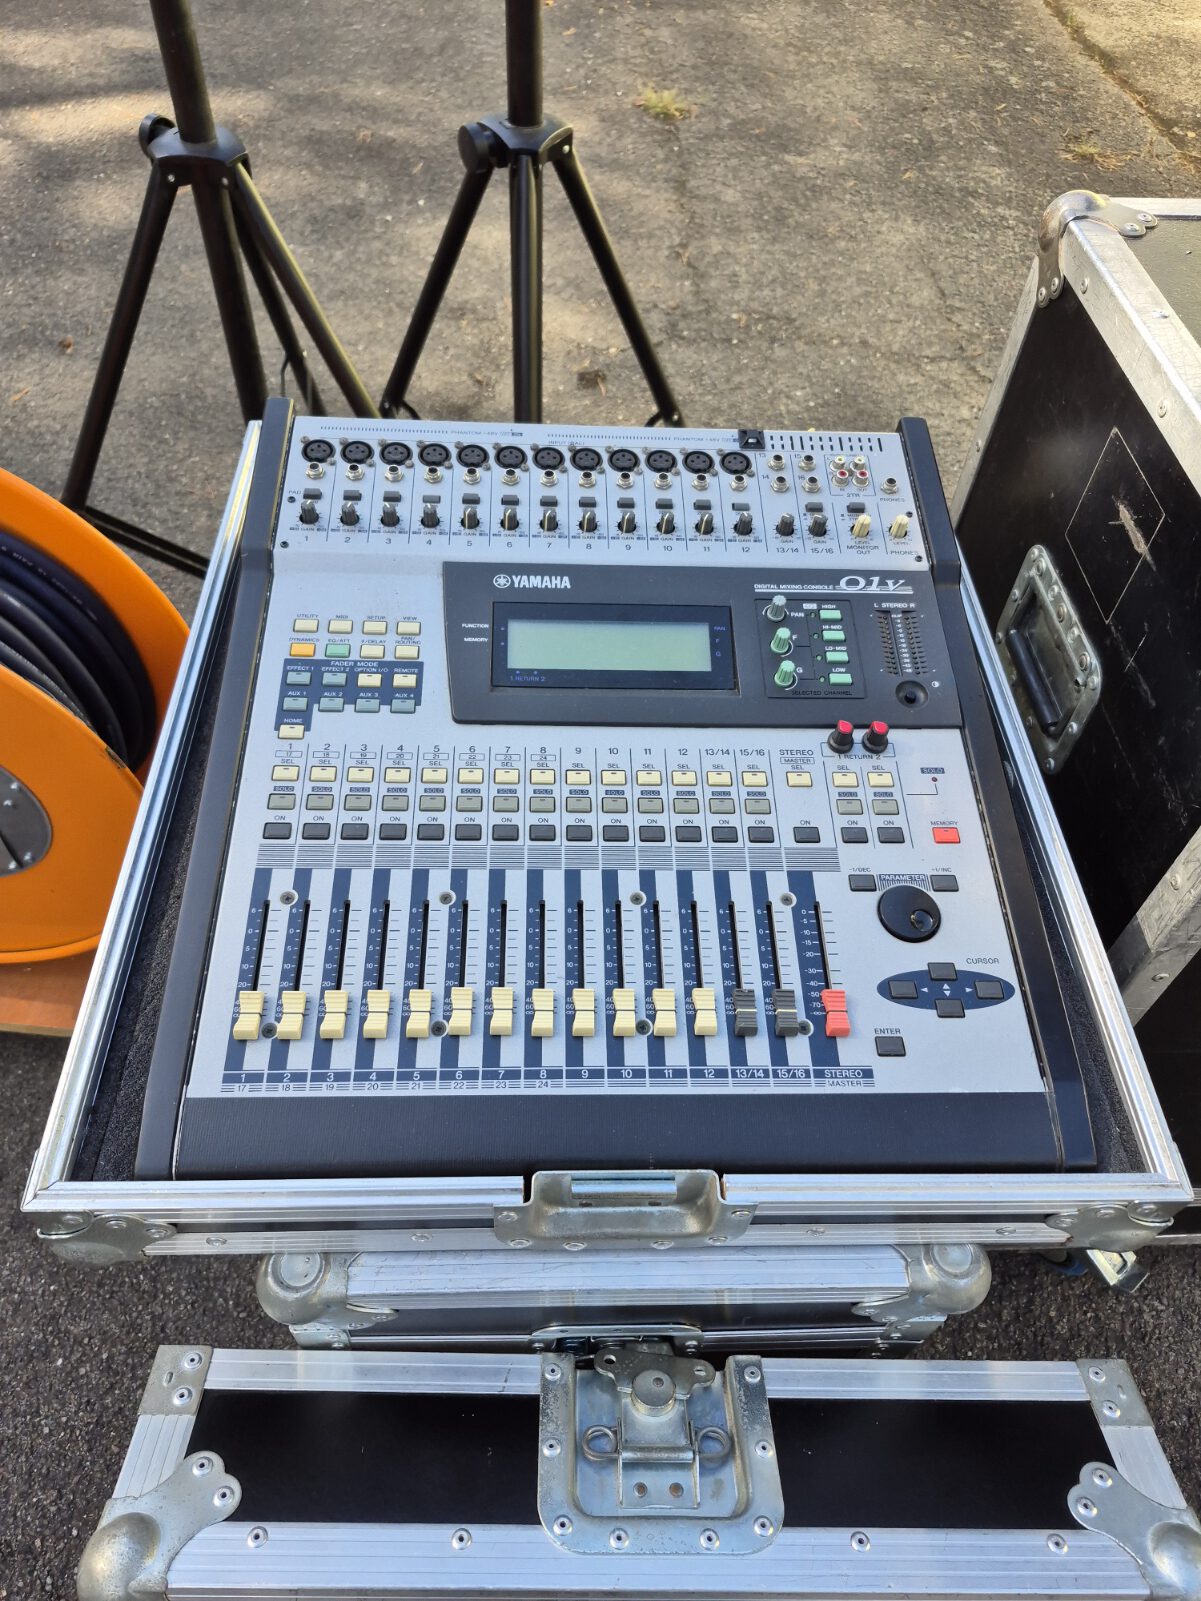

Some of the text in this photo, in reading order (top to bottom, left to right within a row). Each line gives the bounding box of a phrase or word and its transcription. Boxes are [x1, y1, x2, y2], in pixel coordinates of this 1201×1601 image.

[512, 575, 571, 589] YAMAHA
[469, 745, 476, 753] 6
[705, 748, 731, 756] 13/14
[880, 874, 925, 882] PARAMETER
[966, 957, 1000, 965] CURSOR
[240, 1073, 246, 1082] 1
[283, 1073, 291, 1082] 2
[326, 1072, 334, 1082] 3
[369, 1072, 377, 1081] 4
[413, 1072, 421, 1080] 5
[455, 1071, 463, 1080] 6
[498, 1070, 505, 1079] 7
[539, 1070, 547, 1079] 8
[581, 1070, 589, 1078] 9
[620, 1069, 633, 1078] 10
[663, 1069, 673, 1078] 11
[703, 1069, 715, 1078] 12
[735, 1069, 765, 1078] 13/14
[777, 1069, 806, 1078] 15/16
[824, 1069, 863, 1078] STEREO
[238, 1085, 247, 1093] 17
[367, 1083, 379, 1091] 20
[495, 1081, 507, 1089] 23
